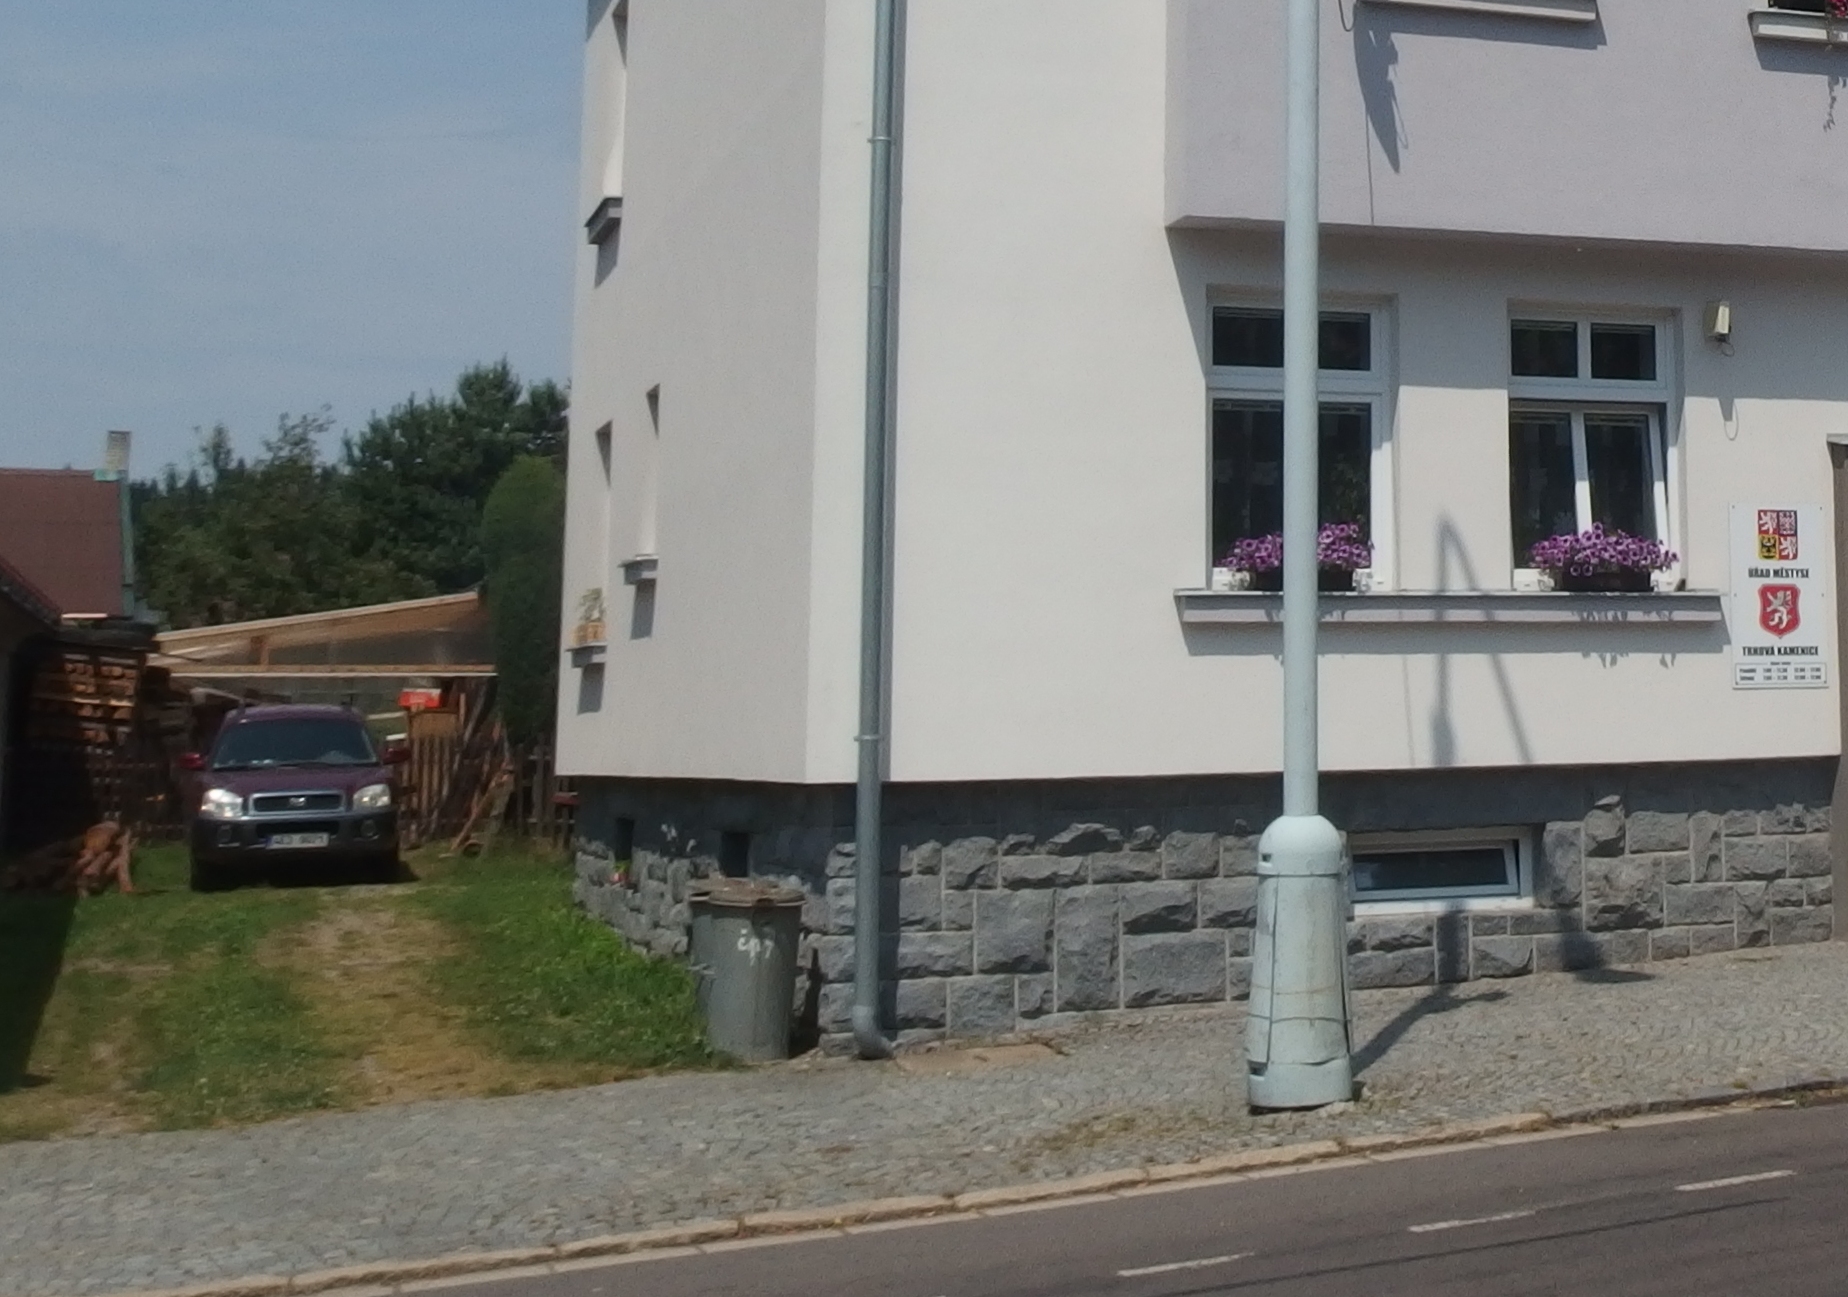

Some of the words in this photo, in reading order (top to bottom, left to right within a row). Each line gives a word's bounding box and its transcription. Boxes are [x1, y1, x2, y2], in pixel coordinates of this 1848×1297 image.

[1773, 567, 1809, 578] MĚSTYSE
[1742, 645, 1776, 656] TRHOVÁ
[1777, 645, 1819, 656] KAMENICE
